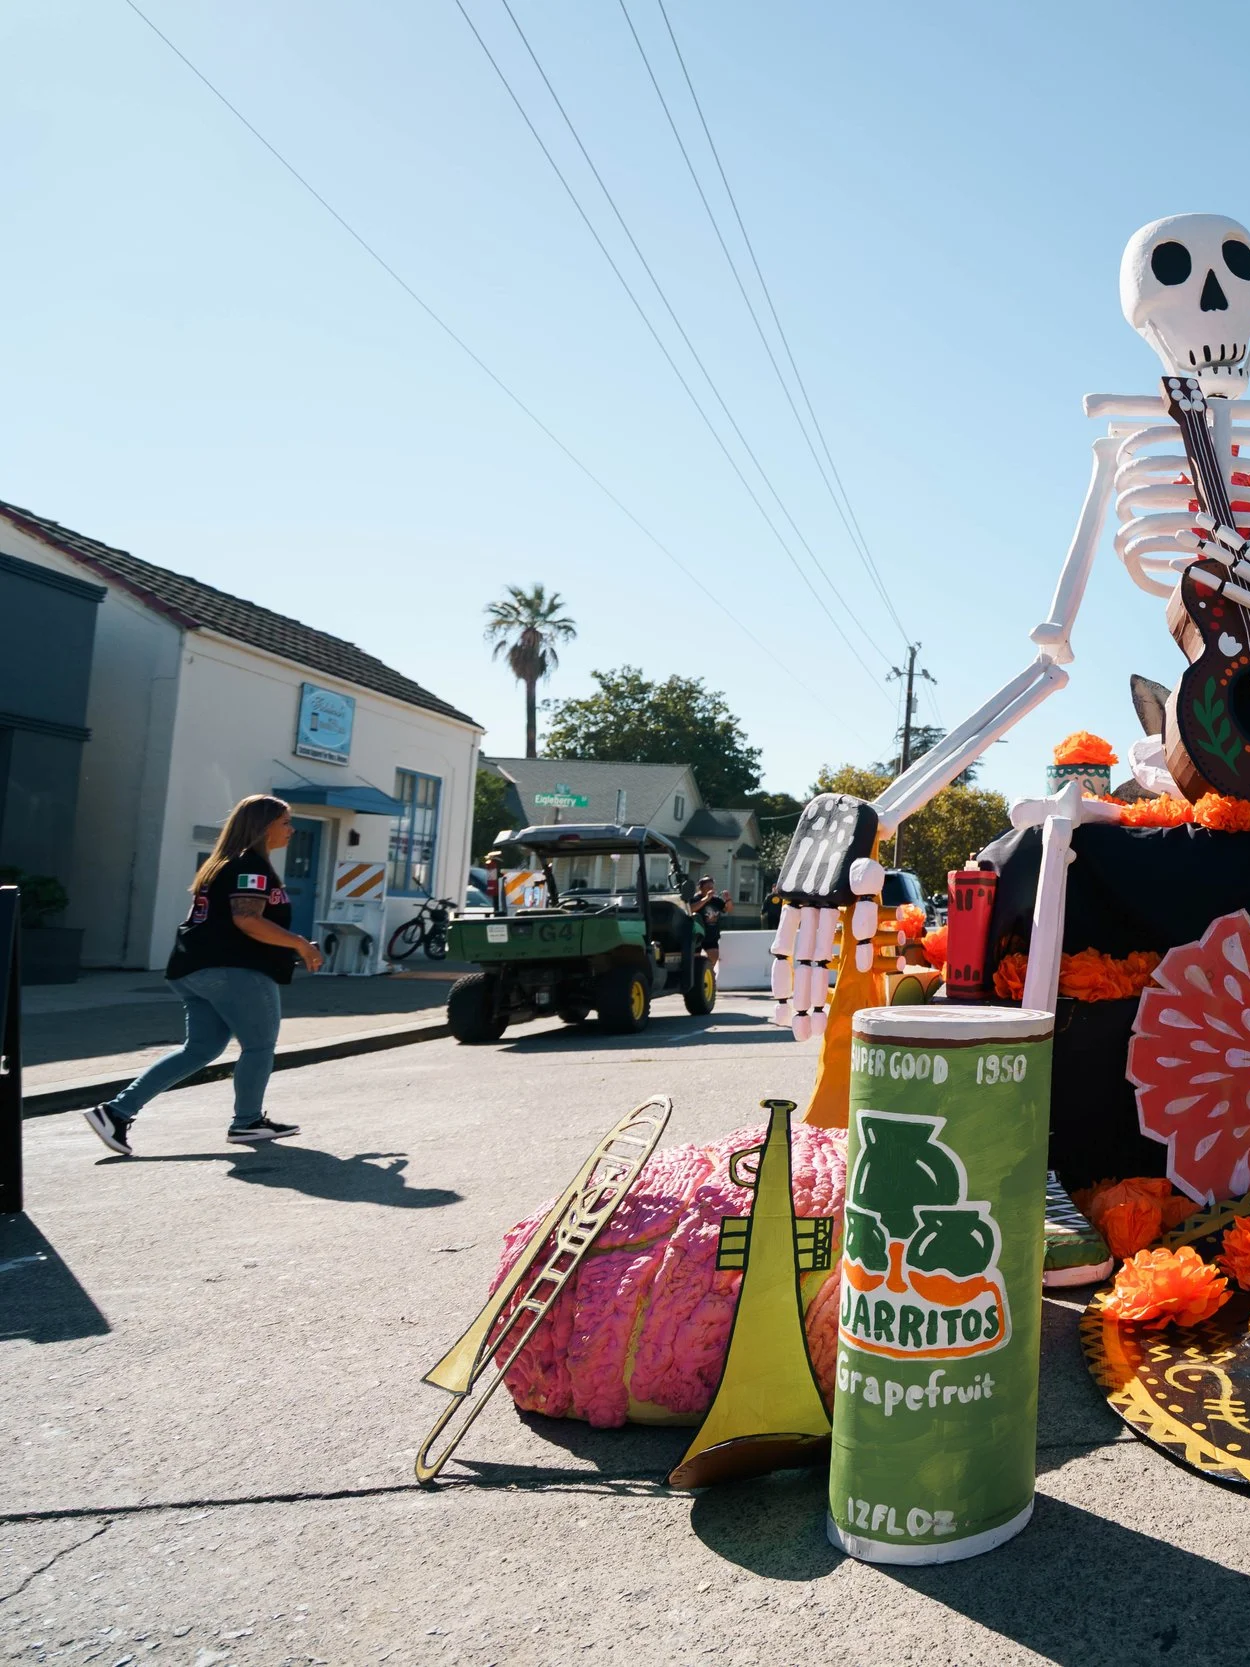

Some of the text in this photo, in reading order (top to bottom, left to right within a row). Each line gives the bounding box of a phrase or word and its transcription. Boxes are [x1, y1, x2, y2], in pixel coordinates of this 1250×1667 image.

[539, 923, 575, 942] G4
[889, 1051, 948, 1085] GOOD
[976, 1053, 1028, 1084] 1950
[841, 1285, 1000, 1349] JARRITOS
[836, 1350, 996, 1417] Grapefruit
